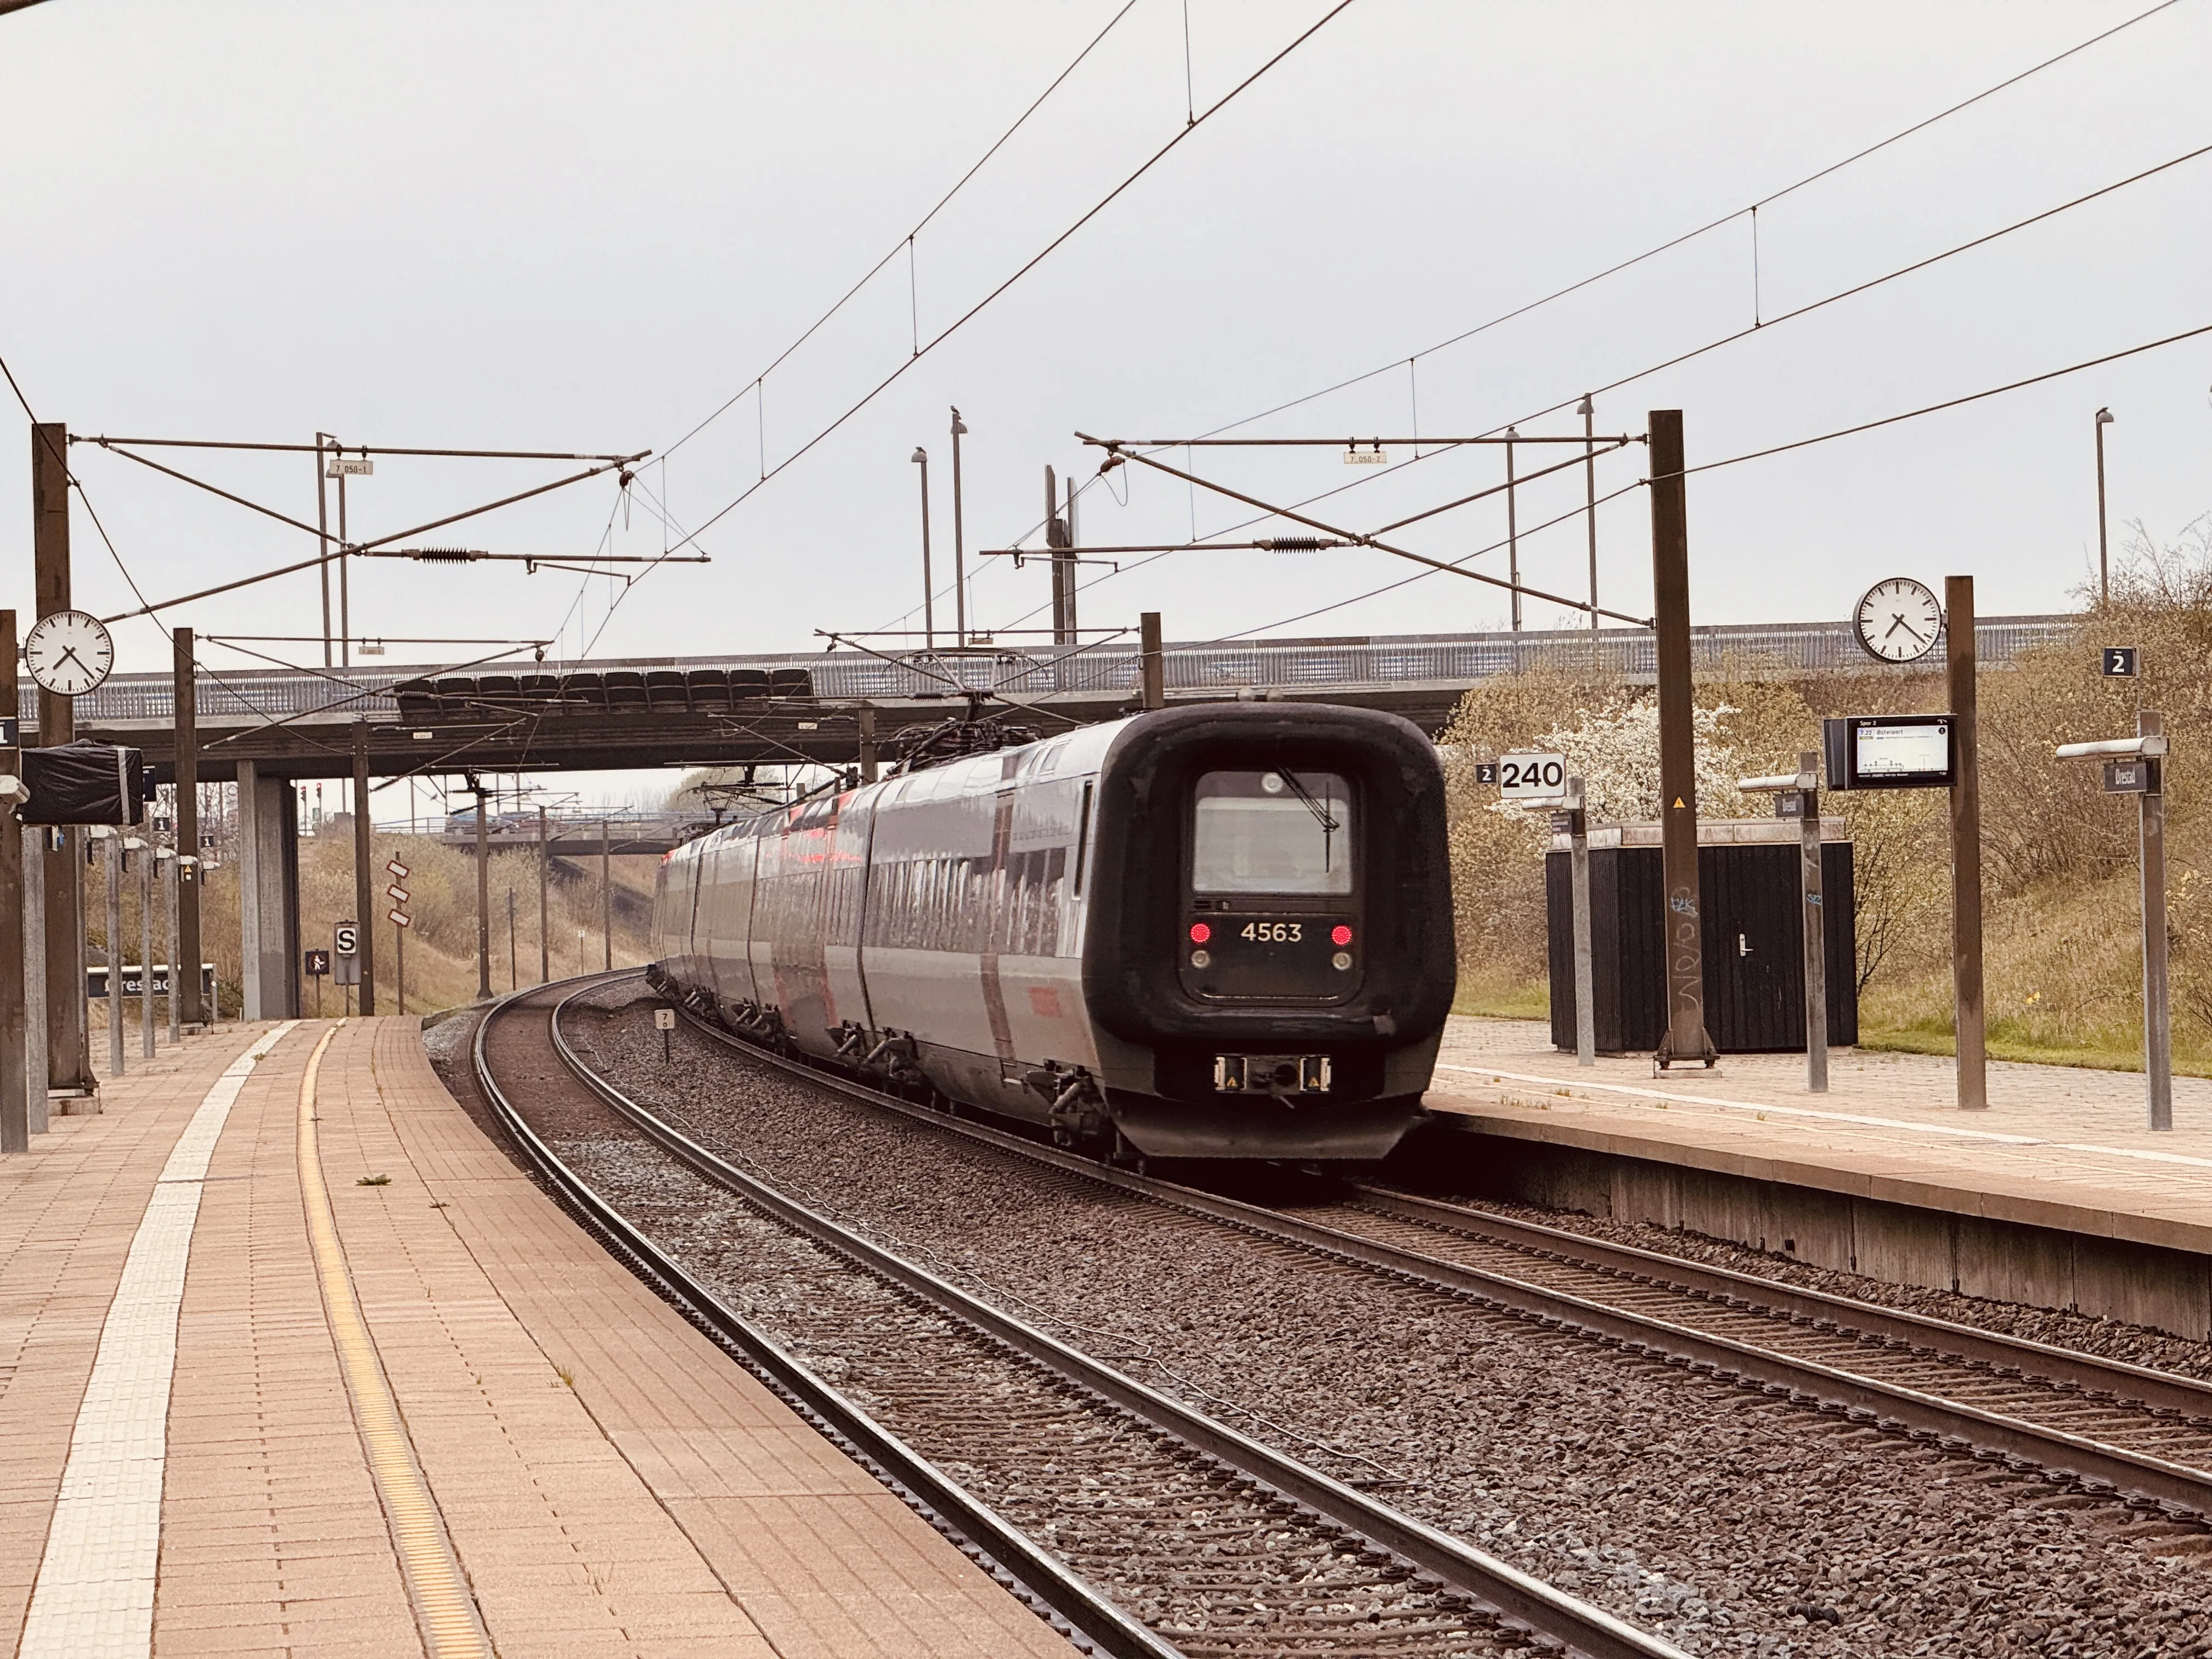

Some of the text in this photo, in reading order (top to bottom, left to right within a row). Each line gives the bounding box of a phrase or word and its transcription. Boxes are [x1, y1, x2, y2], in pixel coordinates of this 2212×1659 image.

[345, 465, 366, 473] 050-1
[2112, 655, 2125, 673] 2
[1482, 769, 1492, 781] 2
[1502, 762, 1563, 788] 240
[158, 820, 165, 830] 1
[204, 837, 211, 847] 1
[1240, 923, 1302, 943] 4563
[338, 930, 356, 951] S
[104, 979, 169, 992] resa
